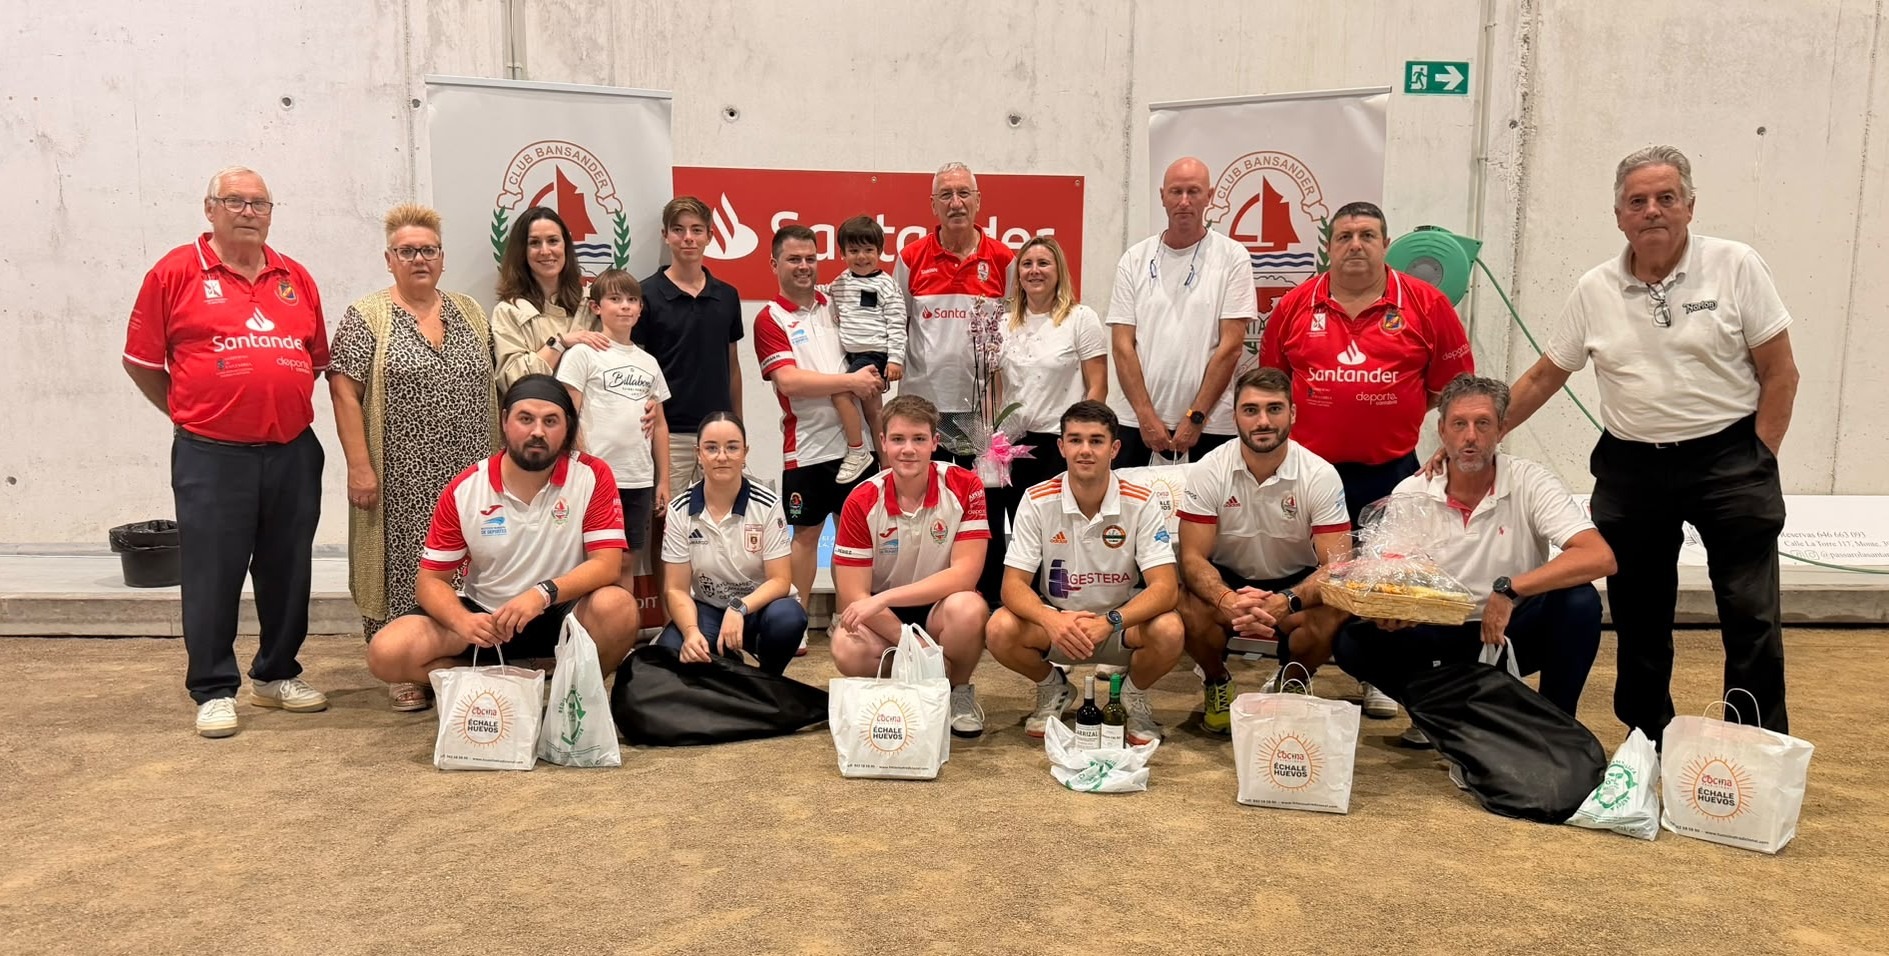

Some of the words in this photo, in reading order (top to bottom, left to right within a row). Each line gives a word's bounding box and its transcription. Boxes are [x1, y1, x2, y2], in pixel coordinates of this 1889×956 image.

[508, 153, 534, 186] CLUB
[535, 145, 609, 189] BANSANDER
[1217, 165, 1242, 200] CLUB
[1243, 155, 1315, 197] BANSANDER
[934, 308, 967, 319] Santa
[212, 332, 305, 352] Santande
[1307, 366, 1399, 383] Santander
[1070, 573, 1131, 585] GESTERA
[468, 719, 498, 727] ÉCHALE
[873, 725, 903, 734] ÉCHALE
[1274, 761, 1307, 771] ÉCHALE
[1274, 770, 1308, 778] HUEVOS
[1697, 787, 1735, 800] ÉCHALE
[1697, 795, 1736, 807] HUEVOS
